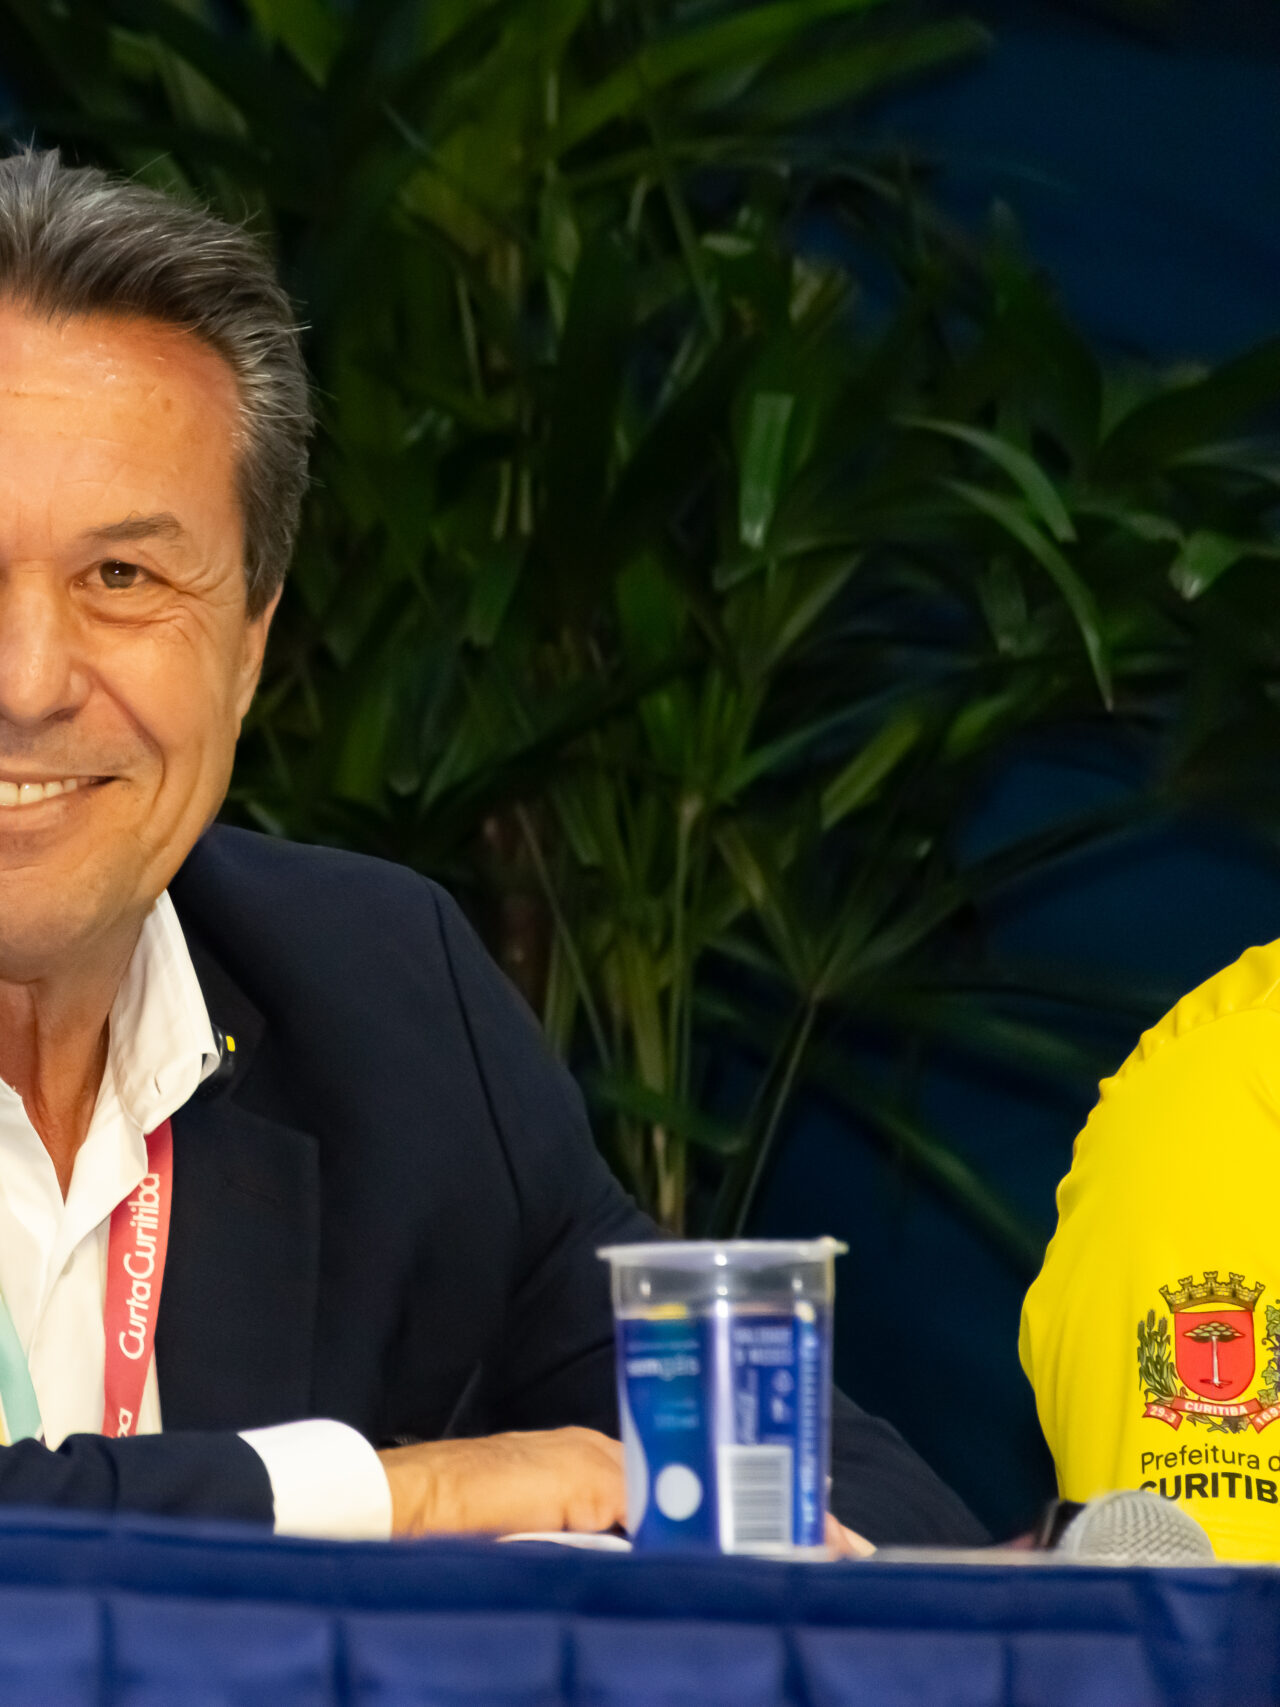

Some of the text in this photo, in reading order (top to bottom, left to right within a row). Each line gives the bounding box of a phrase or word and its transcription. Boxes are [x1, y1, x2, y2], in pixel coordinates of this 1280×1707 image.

[119, 1173, 160, 1360] CurtaCuritiba
[1184, 1401, 1248, 1416] CURITIBA
[1255, 1404, 1280, 1426] 169
[1141, 1443, 1260, 1475] Prefeitura
